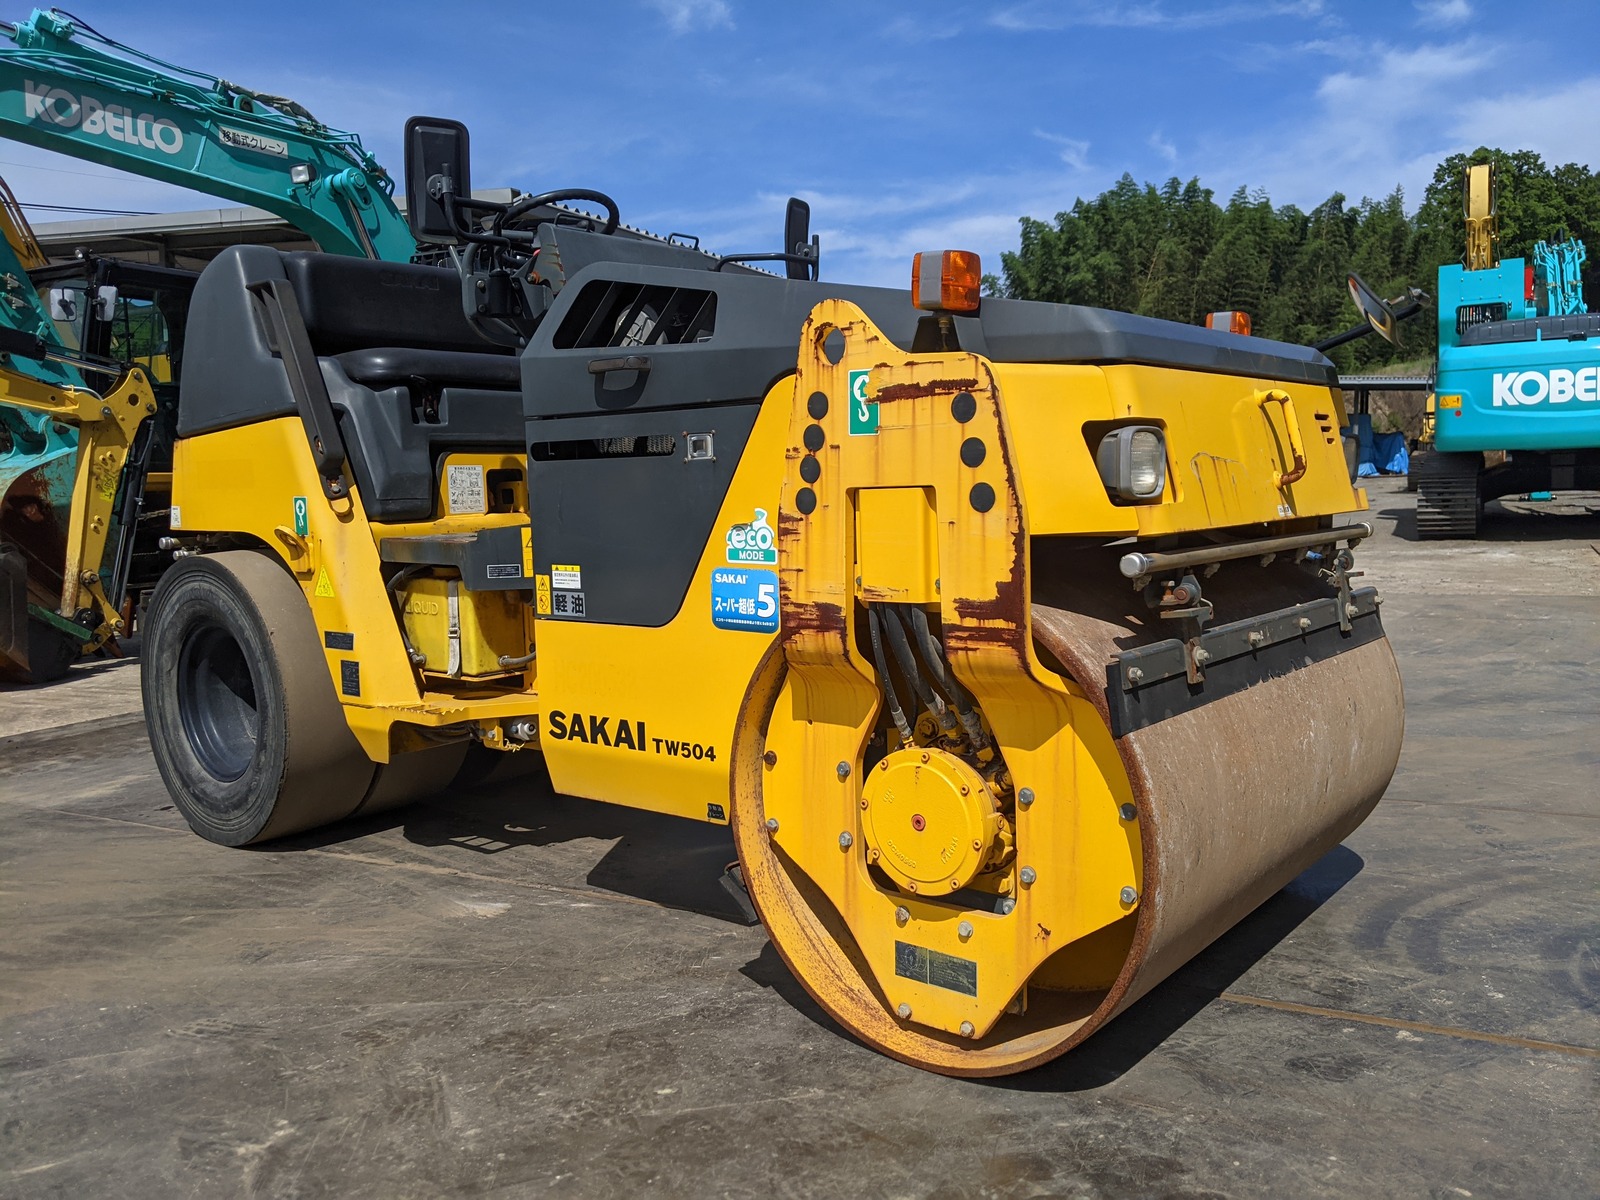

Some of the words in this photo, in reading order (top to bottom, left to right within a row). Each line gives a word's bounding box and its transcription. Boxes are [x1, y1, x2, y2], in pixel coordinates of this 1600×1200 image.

[24, 79, 183, 154] KOBELCO
[222, 130, 284, 154] 移動式クレーン
[1492, 367, 1600, 407] KOBE
[731, 527, 773, 550] eco
[738, 550, 764, 560] MODE
[715, 573, 747, 584] SAKAI
[405, 601, 439, 616] LIQUID
[554, 593, 584, 614] 軽油
[757, 584, 776, 618] 5
[549, 710, 646, 752] SAKAI
[652, 738, 716, 762] TW504
